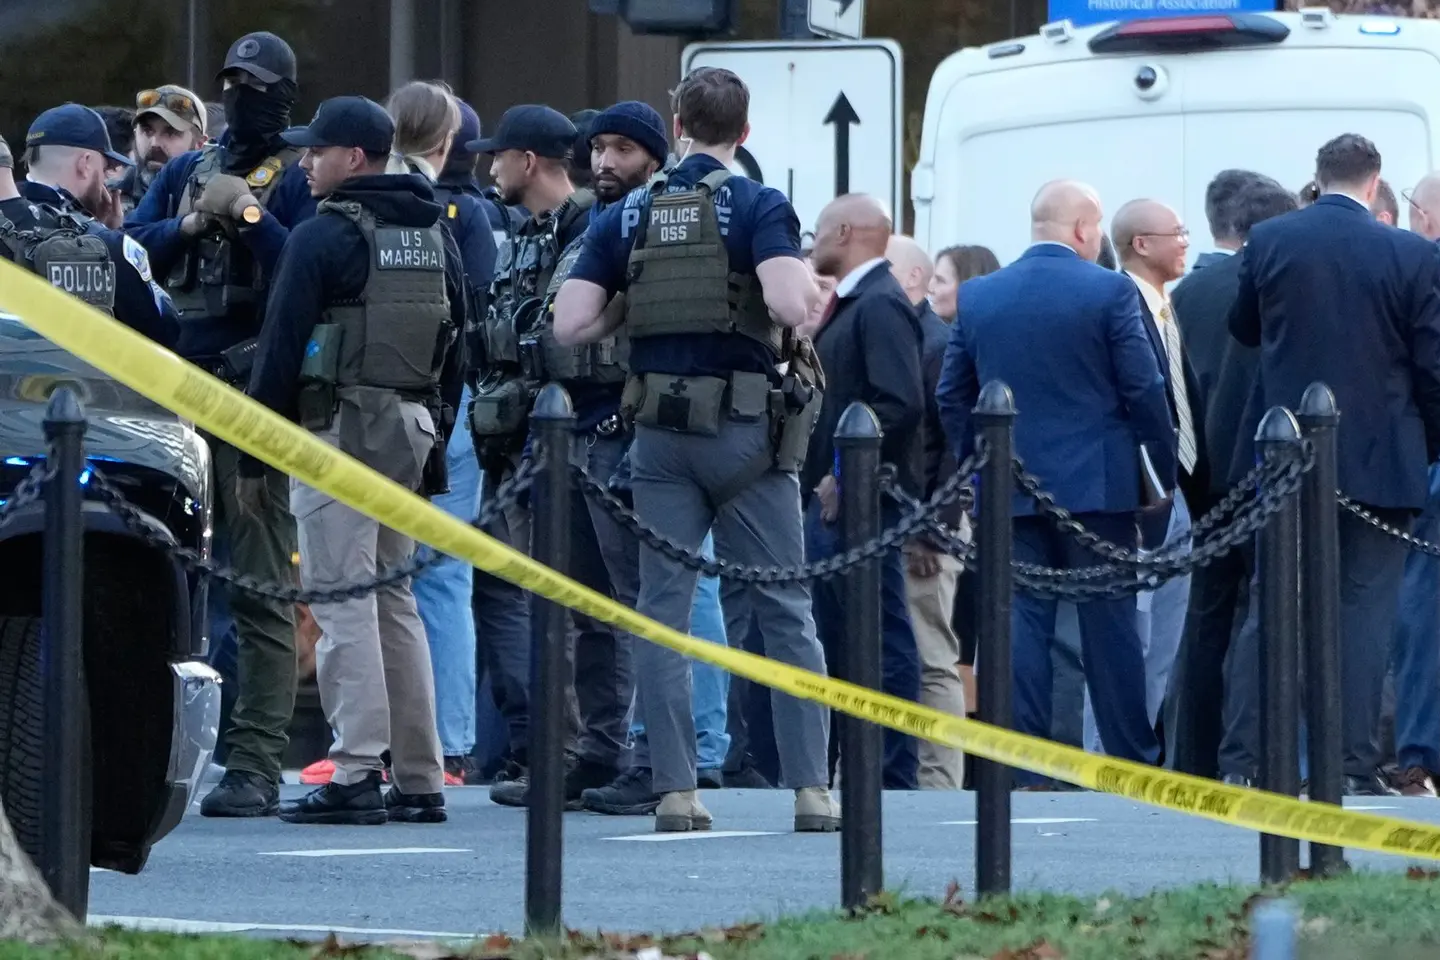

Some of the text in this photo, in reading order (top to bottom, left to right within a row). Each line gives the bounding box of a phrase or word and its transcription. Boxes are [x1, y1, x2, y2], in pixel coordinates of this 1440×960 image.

[652, 207, 700, 225] POLICE
[660, 226, 687, 241] DSS
[51, 265, 113, 292] POLICE
